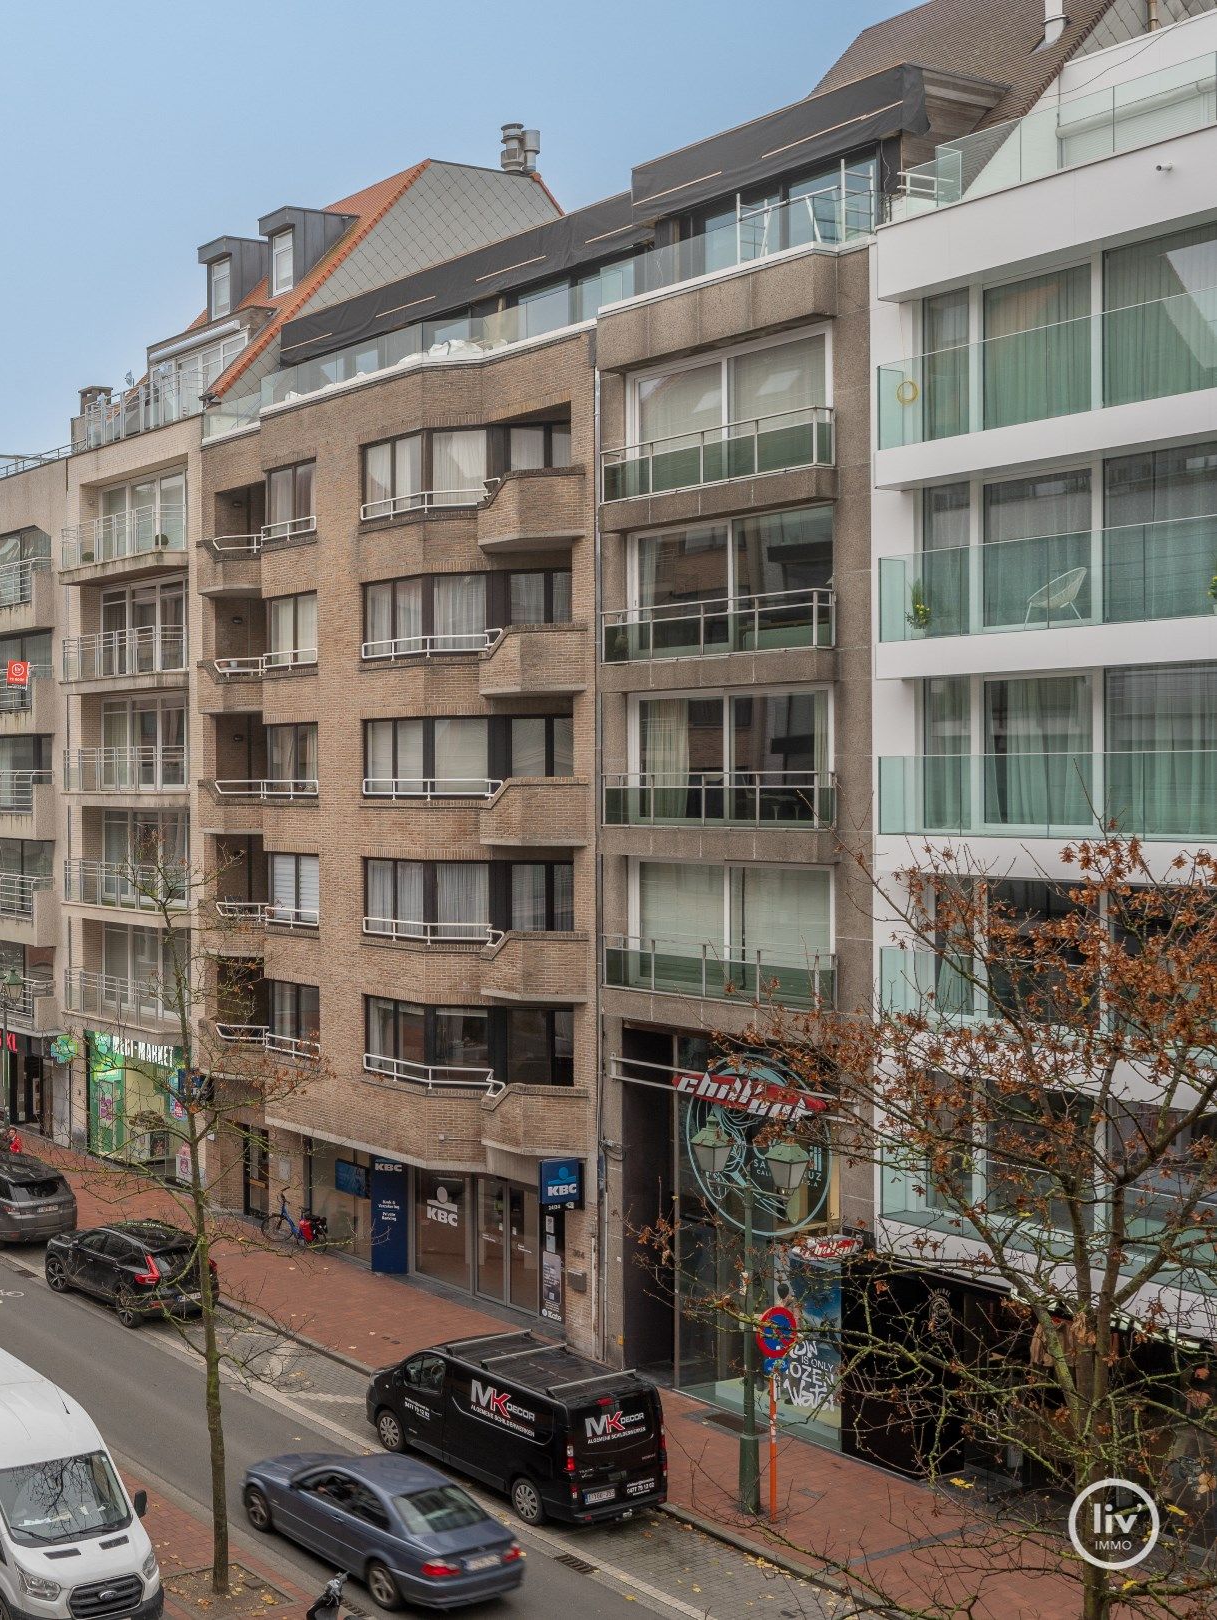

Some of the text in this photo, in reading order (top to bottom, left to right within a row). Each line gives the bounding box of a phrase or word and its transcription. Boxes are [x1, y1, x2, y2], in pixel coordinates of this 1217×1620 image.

[375, 1162, 403, 1172] KBC
[547, 1183, 577, 1197] KBC
[427, 1206, 458, 1227] KBC
[801, 1355, 834, 1373] IS ONLY
[471, 1379, 535, 1422] MK DECOR
[471, 1404, 494, 1420] ALGEMENE
[585, 1410, 645, 1438] MK DECOR
[587, 1434, 611, 1444] ALGEMENE
